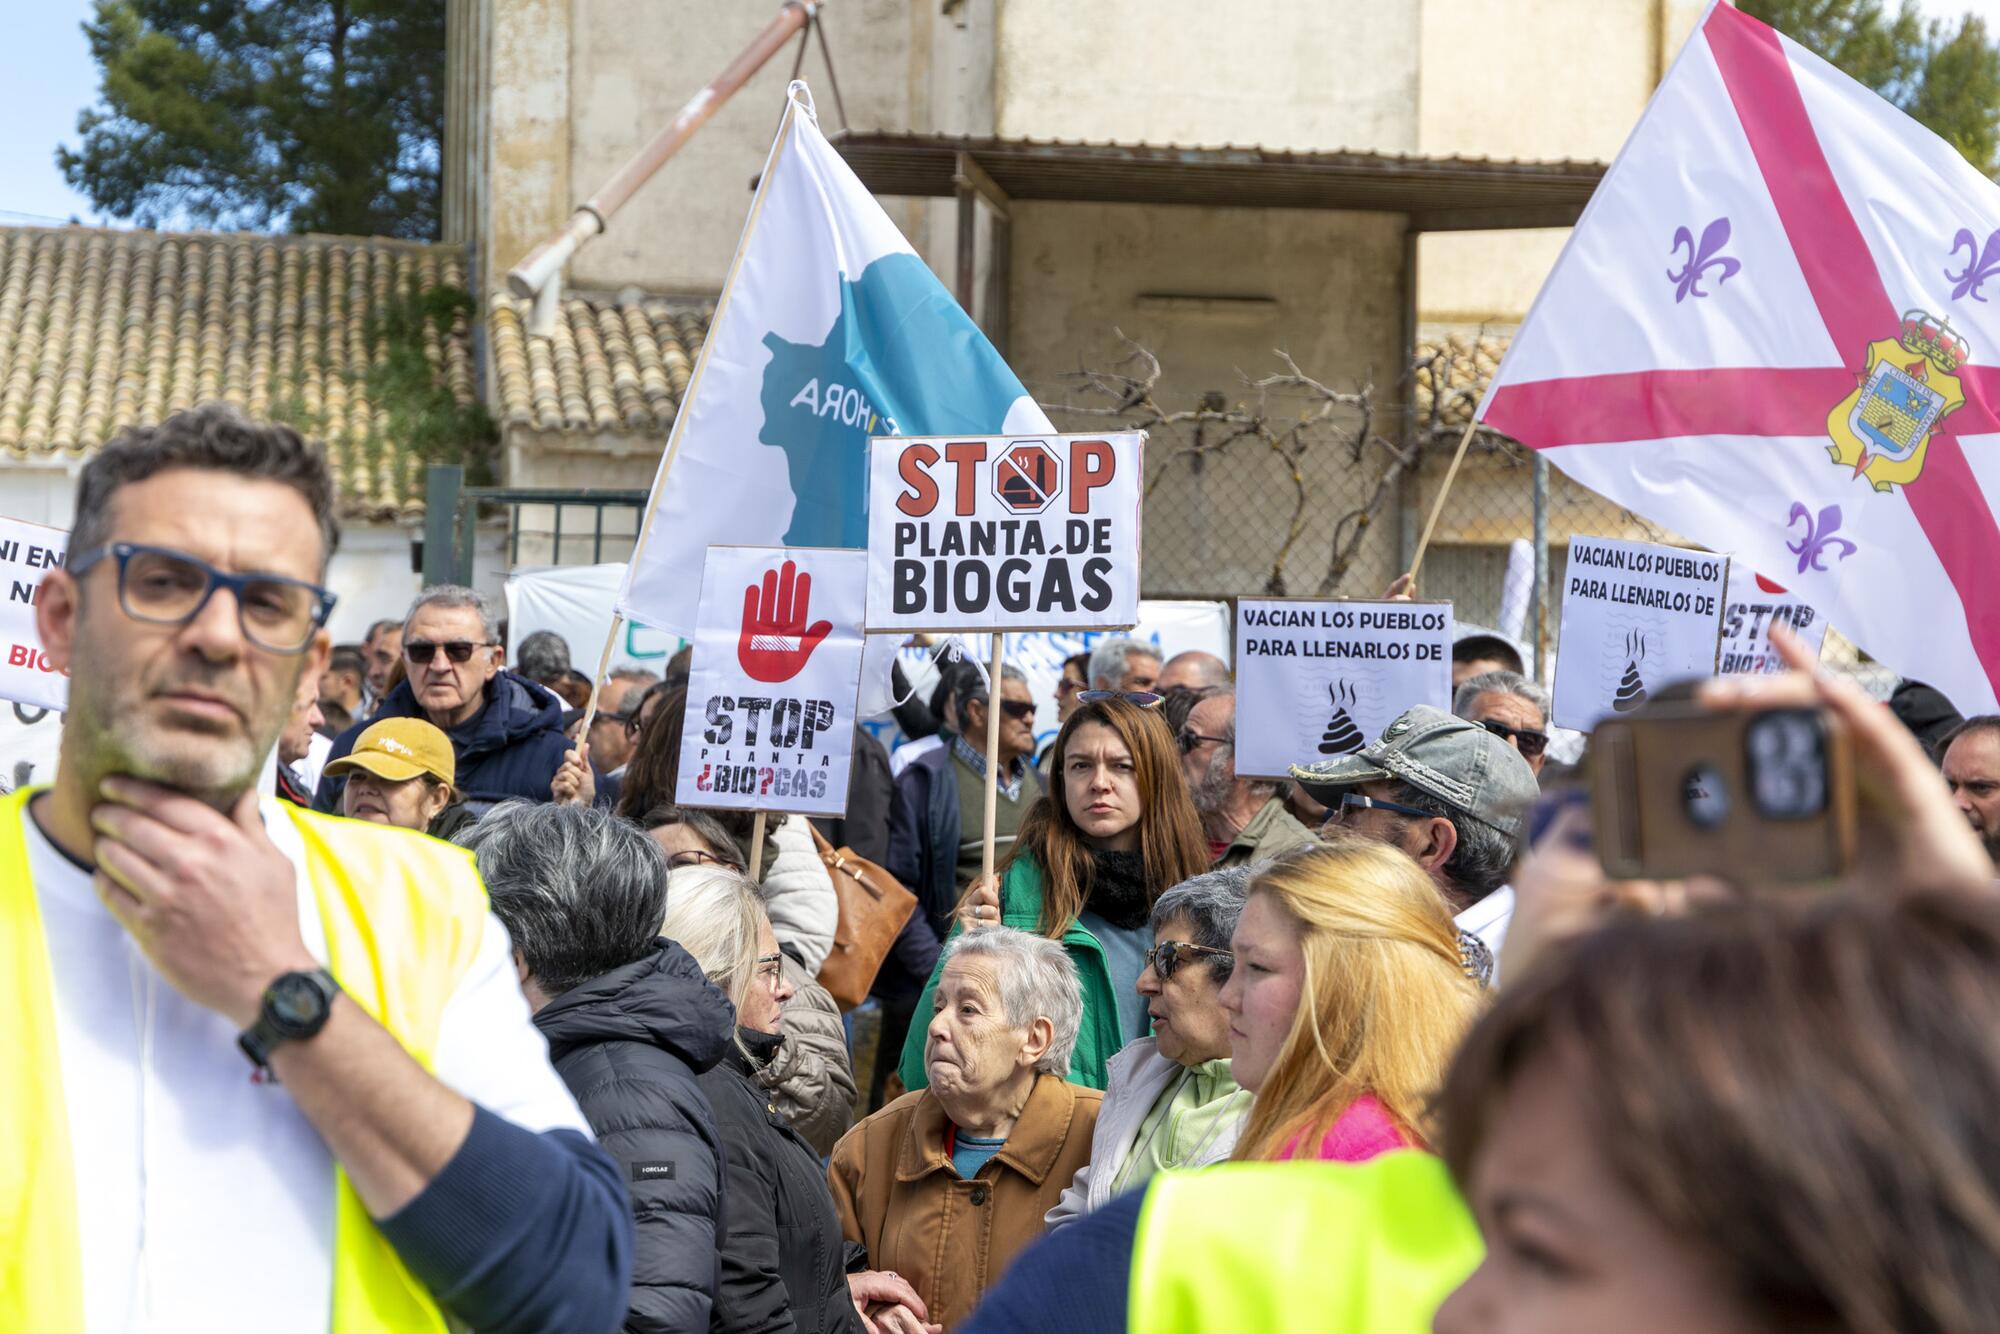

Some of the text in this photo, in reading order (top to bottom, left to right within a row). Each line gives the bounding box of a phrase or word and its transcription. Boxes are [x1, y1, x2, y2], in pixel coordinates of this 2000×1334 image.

[895, 440, 1116, 517] STOP
[894, 518, 1112, 557] PLANTA DE
[892, 544, 1113, 614] BIOGÁS
[1574, 544, 1720, 582] VACIAN LOS PUEBLOS
[1570, 578, 1715, 616] PARA LLENARLOS DE
[1244, 609, 1445, 631] VACIAN LOS PUEBLOS
[8, 644, 72, 678] BIO
[1246, 639, 1442, 660] PARA LLENARLOS DE
[703, 695, 835, 750] STOP
[700, 748, 829, 767] PLANTA
